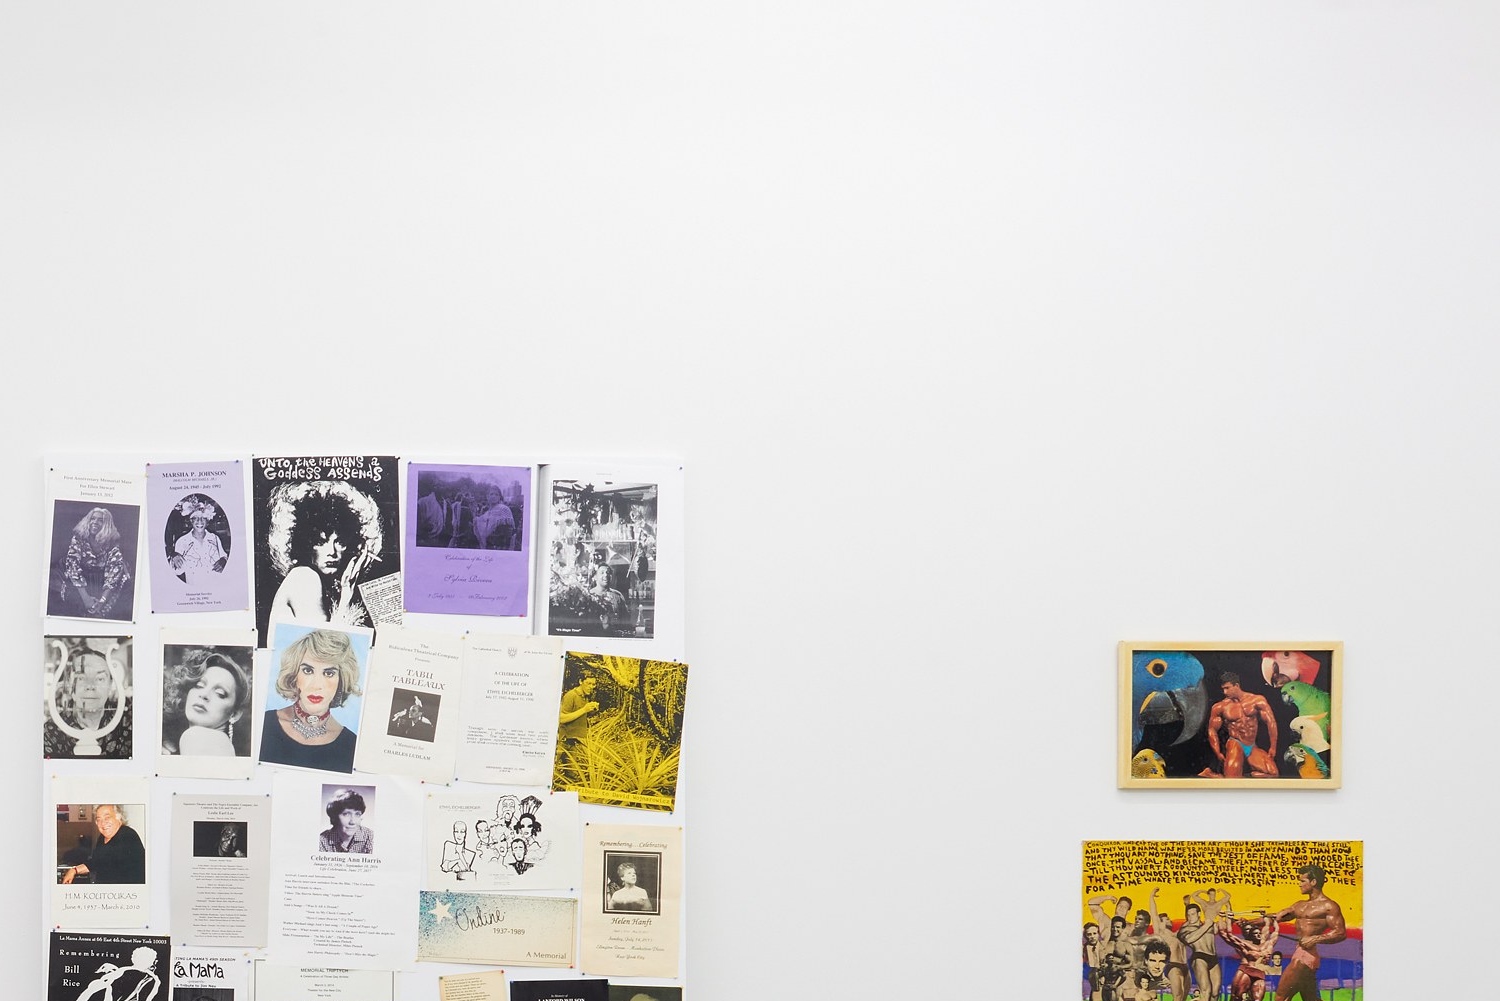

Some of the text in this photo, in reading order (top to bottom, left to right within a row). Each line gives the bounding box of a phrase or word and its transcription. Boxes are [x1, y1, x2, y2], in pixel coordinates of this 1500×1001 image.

[258, 457, 290, 468] UNTO
[296, 457, 316, 467] the
[310, 854, 346, 864] Celebrating
[1086, 886, 1106, 894] FOR
[611, 917, 652, 927] Helen Hanft
[492, 928, 526, 936] 1937-1989
[60, 950, 120, 959] Remembering
[533, 952, 567, 960] Memorial
[64, 965, 80, 974] Bill
[62, 978, 80, 987] Rice
